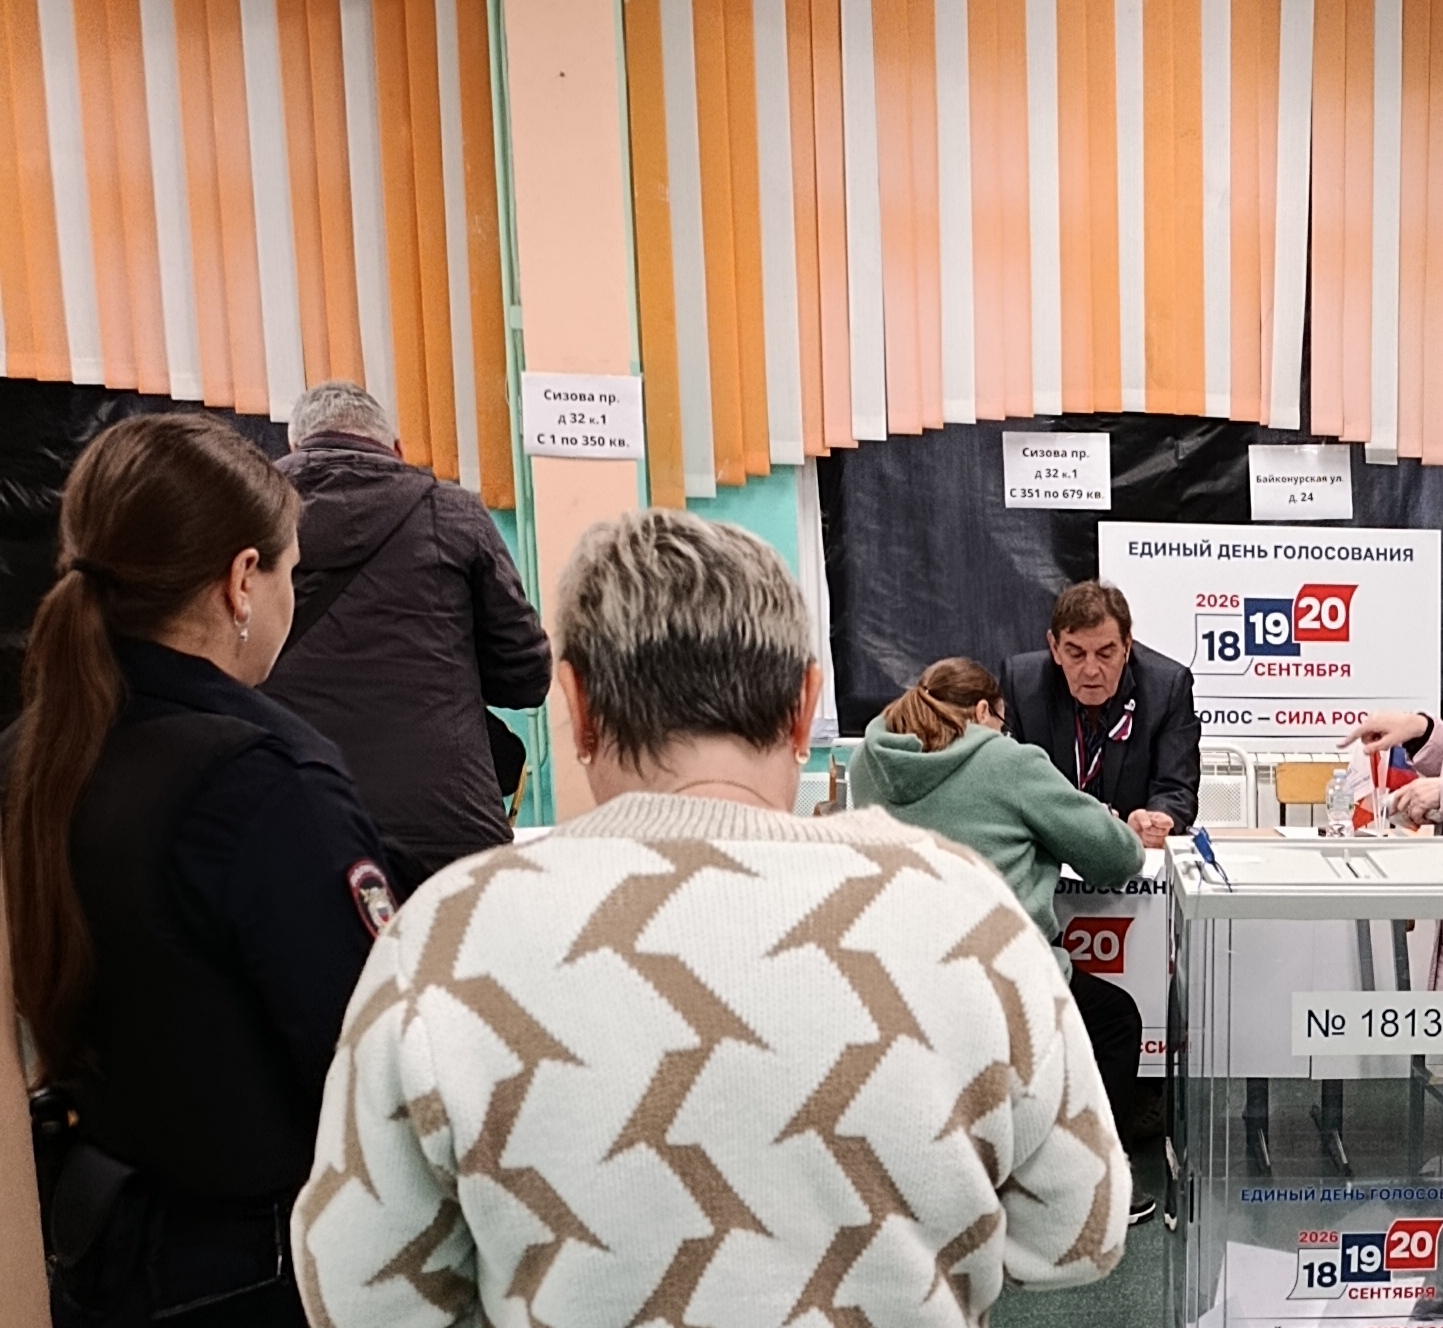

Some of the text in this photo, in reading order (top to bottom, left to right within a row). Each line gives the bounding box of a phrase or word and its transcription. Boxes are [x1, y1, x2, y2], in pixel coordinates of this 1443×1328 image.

[543, 389, 620, 406] Сизова пр.
[569, 412, 586, 425] 32
[536, 433, 630, 448] С 1 по 350 кв.
[1022, 447, 1090, 462] Сизова пр.
[1045, 468, 1059, 479] 32
[1256, 474, 1343, 486] Байконурская ул.
[1009, 488, 1105, 500] С 351 по 679 кв.
[1288, 492, 1314, 504] д. 24
[1128, 539, 1414, 562] ЕДИНЫЙ ДЕНЬ ГОЛОСОВАНИЯ
[1196, 593, 1240, 608] 2026
[1298, 597, 1347, 630] 20
[1249, 612, 1290, 645] 19
[1201, 630, 1240, 662] 18
[1254, 662, 1351, 677] СЕНТЯБРЯ
[1275, 710, 1326, 725] СИЛА
[1068, 930, 1120, 961] 20
[1307, 1008, 1443, 1038] № 1813
[1241, 1186, 1315, 1203] ЕДИНЫЙ
[1320, 1188, 1365, 1203] ДЕНЬ
[1299, 1231, 1338, 1244] 2026
[1389, 1231, 1433, 1260] 20
[1346, 1245, 1382, 1274] 19
[1302, 1262, 1338, 1289] 18
[1349, 1286, 1436, 1300] СЕНТЯБРЯ
